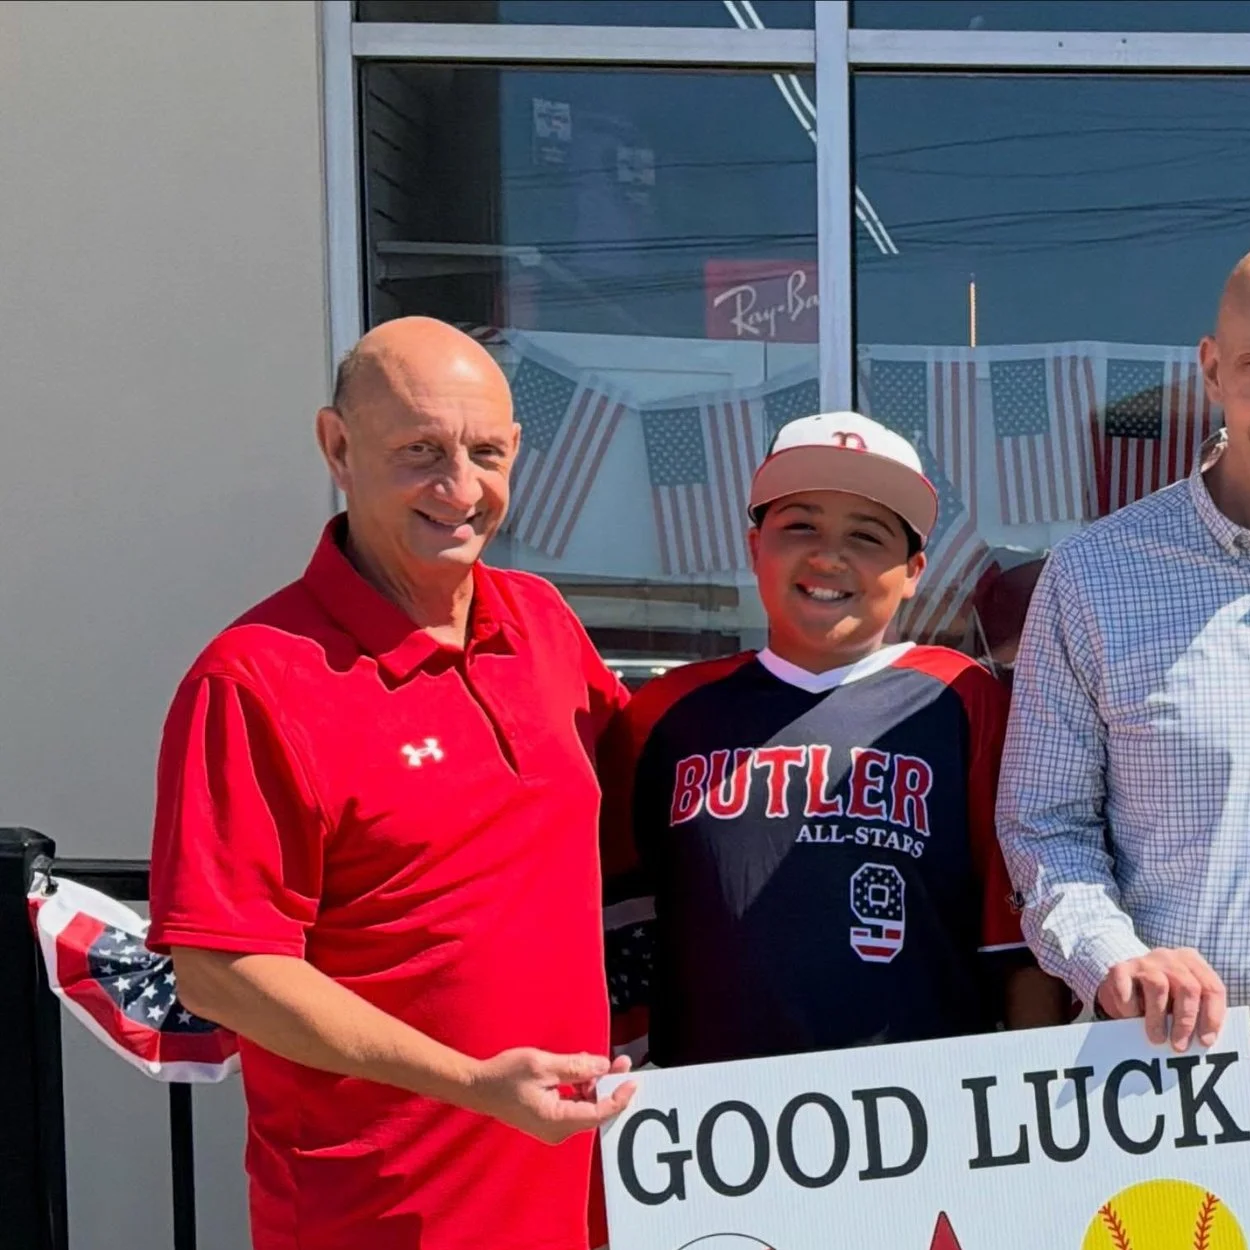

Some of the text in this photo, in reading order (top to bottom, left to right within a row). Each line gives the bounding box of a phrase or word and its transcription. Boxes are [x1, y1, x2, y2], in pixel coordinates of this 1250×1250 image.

[714, 269, 819, 337] Ray-Ba
[669, 744, 933, 837] BUTLER
[795, 824, 925, 858] ALL-STARS
[850, 862, 905, 963] 9
[616, 1051, 1250, 1206] GOOD LUCK
